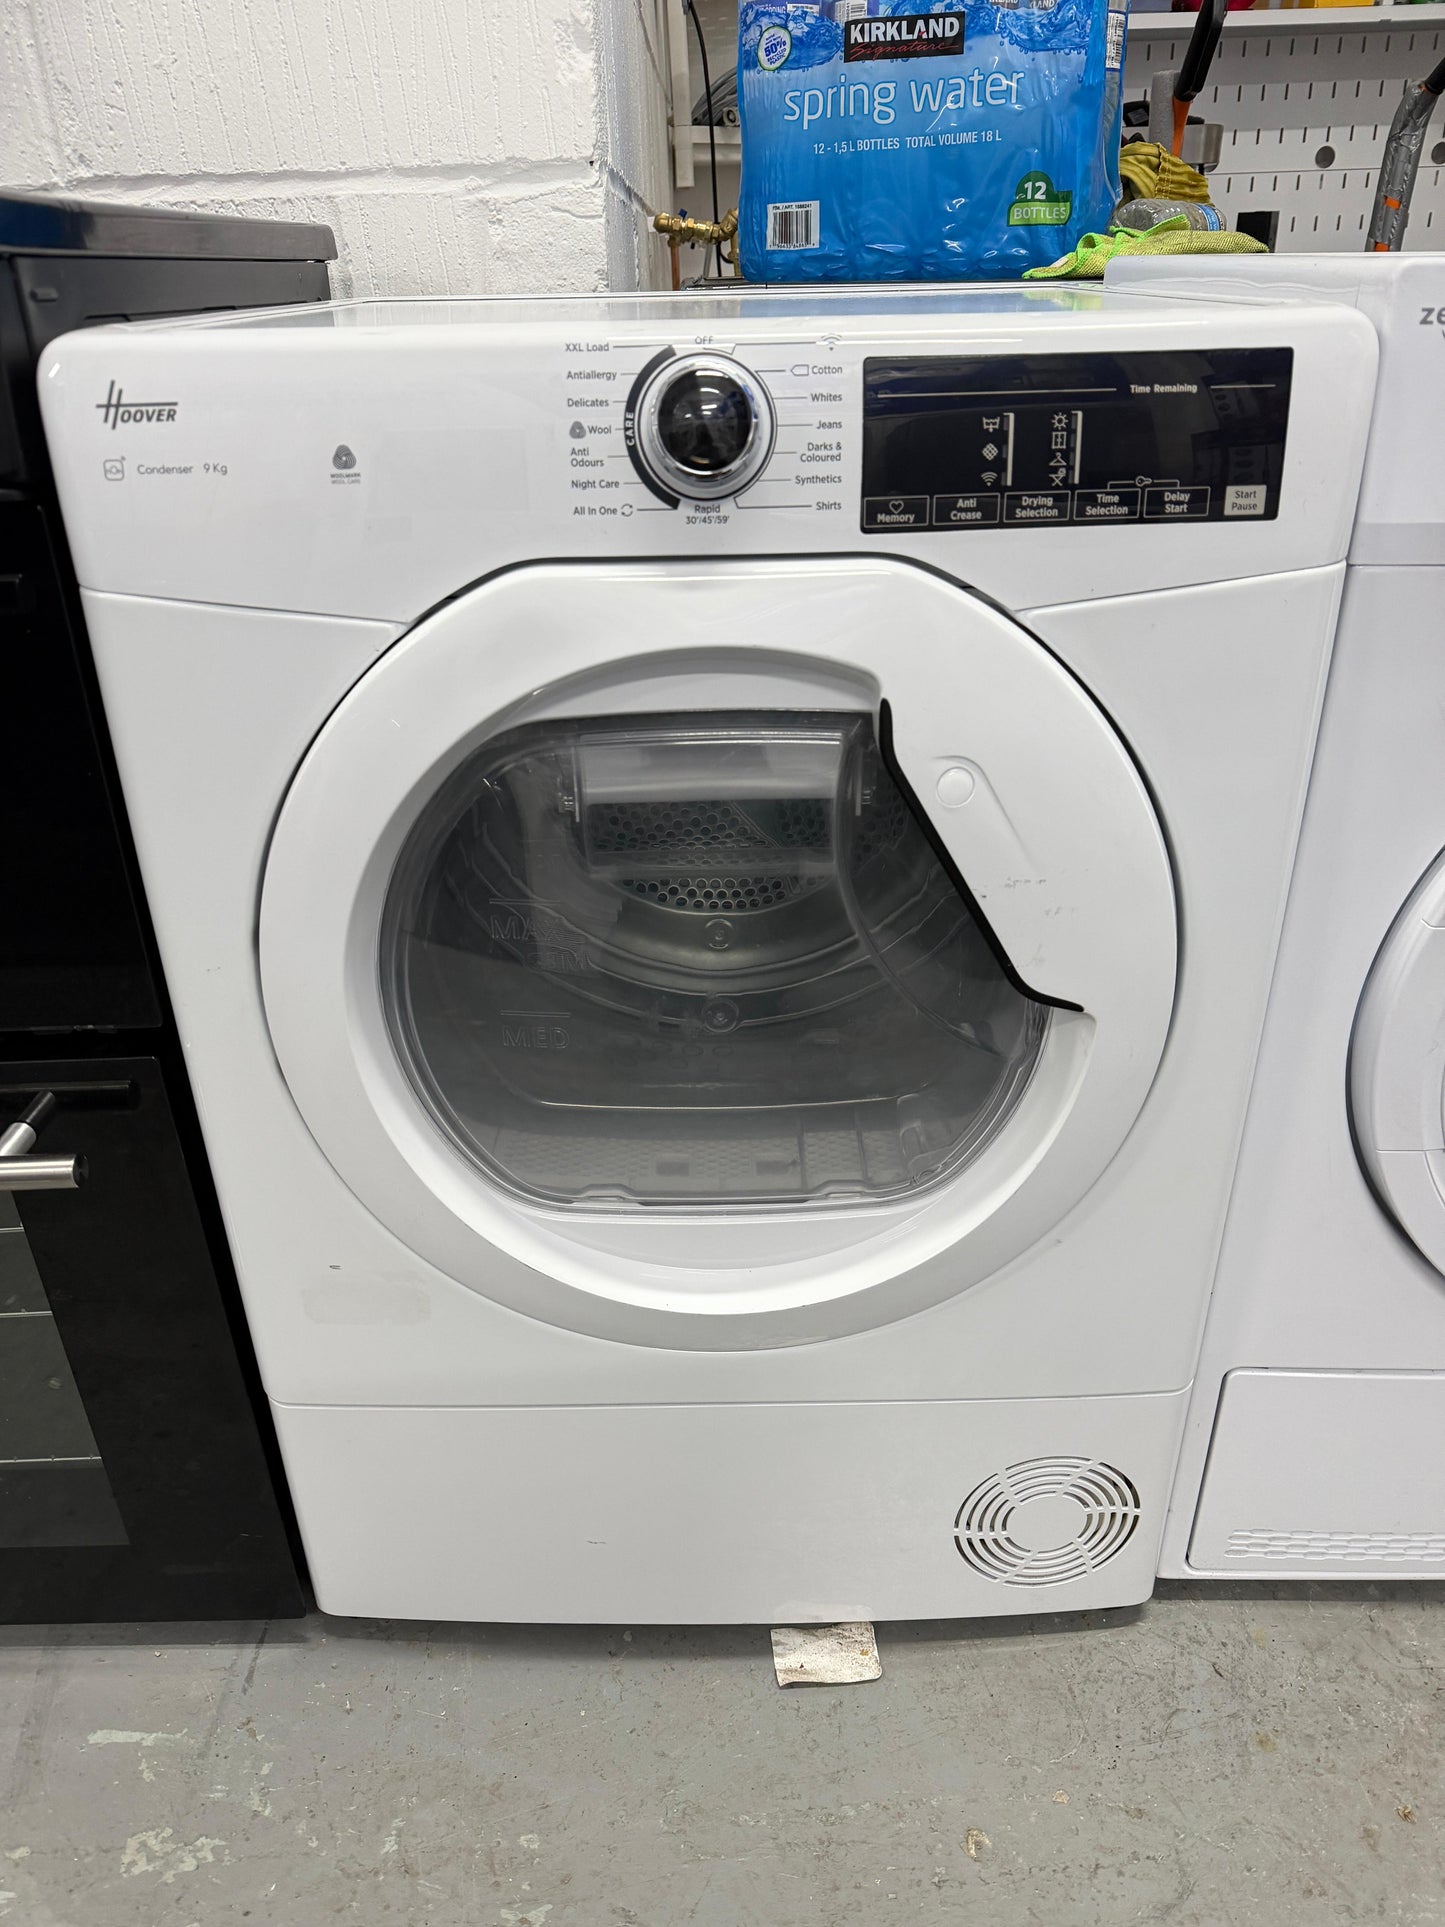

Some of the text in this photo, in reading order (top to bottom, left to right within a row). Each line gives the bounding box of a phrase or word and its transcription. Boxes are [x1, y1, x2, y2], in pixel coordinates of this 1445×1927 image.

[850, 17, 960, 44] KIRKLAND
[764, 38, 787, 57] 50%
[849, 41, 959, 60] Signature
[783, 68, 1025, 131] spring water
[813, 143, 825, 155] 12
[834, 142, 847, 155] 1,5
[850, 140, 855, 152] L
[857, 137, 900, 151] BOTTLES
[905, 135, 937, 148] TOTAL
[938, 131, 978, 146] VOLUME
[981, 130, 993, 143] 18
[995, 129, 1002, 141] L
[1024, 181, 1047, 200] 12
[1013, 206, 1067, 220] BOTTLES
[695, 336, 714, 345] OFF
[565, 342, 610, 352] XXL Load
[566, 370, 617, 381] Antiallergy
[811, 365, 843, 375] Cotton
[1130, 383, 1198, 394] Time Remaining
[810, 392, 843, 402] Whites
[567, 398, 610, 408] Delicates
[587, 425, 612, 435] Wool
[625, 411, 635, 447] CARE
[816, 420, 843, 430] Jeans
[570, 447, 590, 457] Anti
[807, 441, 842, 452] Darks &
[570, 457, 605, 468] Odours
[800, 452, 842, 463] Coloured
[137, 462, 228, 476] Condenser 9 Kg
[571, 479, 620, 491] Night Care
[795, 475, 842, 486] Synthetics
[1096, 493, 1120, 504] Time
[1164, 491, 1190, 502] Delay
[1234, 489, 1257, 499] Start
[816, 501, 842, 511] Shirts
[956, 498, 977, 508] Anti
[1021, 496, 1053, 507] Drying
[1231, 501, 1258, 512] Pause
[573, 506, 618, 516] All In One
[694, 504, 721, 514] Rapid
[1015, 506, 1058, 518] Selection
[1085, 505, 1129, 516] Selection
[1164, 502, 1188, 513] Start
[877, 513, 915, 523] Memory
[950, 510, 982, 521] Crease
[502, 1025, 570, 1049] MED
